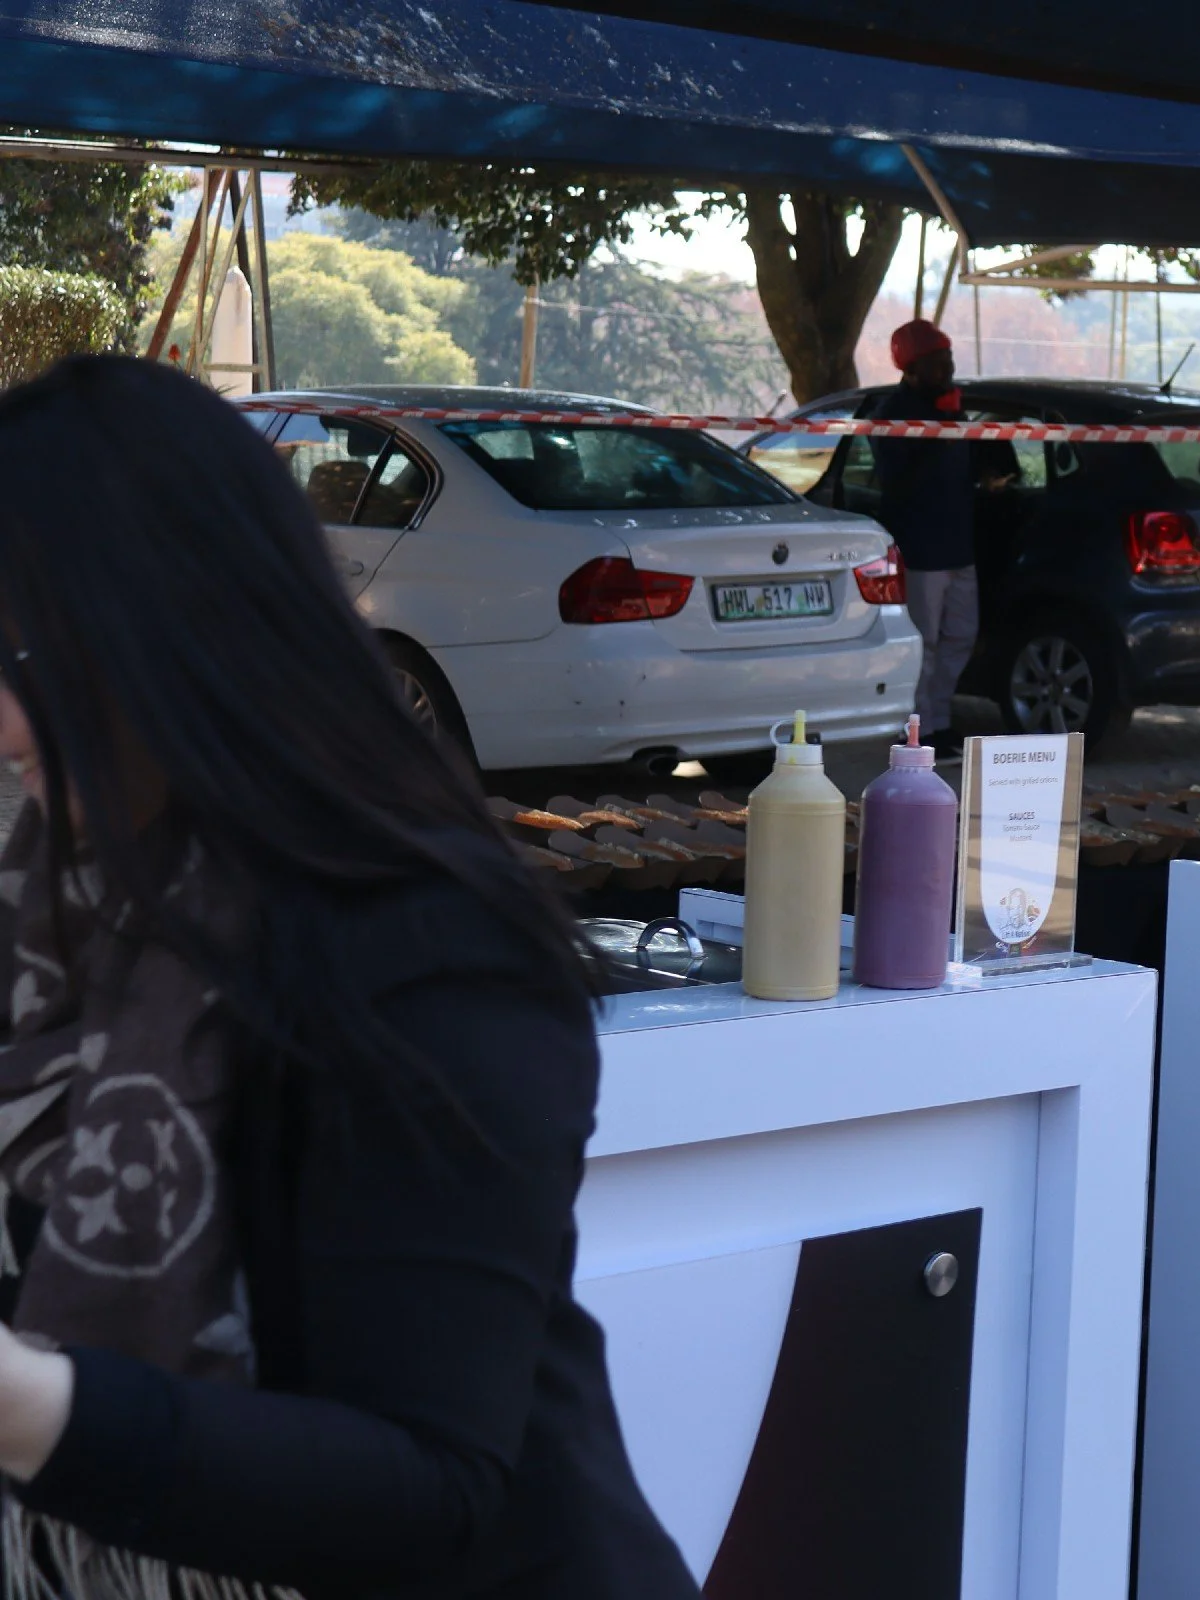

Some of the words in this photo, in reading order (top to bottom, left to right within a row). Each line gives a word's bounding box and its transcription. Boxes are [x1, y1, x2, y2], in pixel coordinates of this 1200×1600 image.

[993, 752, 1027, 765] BOERIE
[1028, 751, 1057, 763] MENU
[1008, 811, 1036, 821] SAUCES
